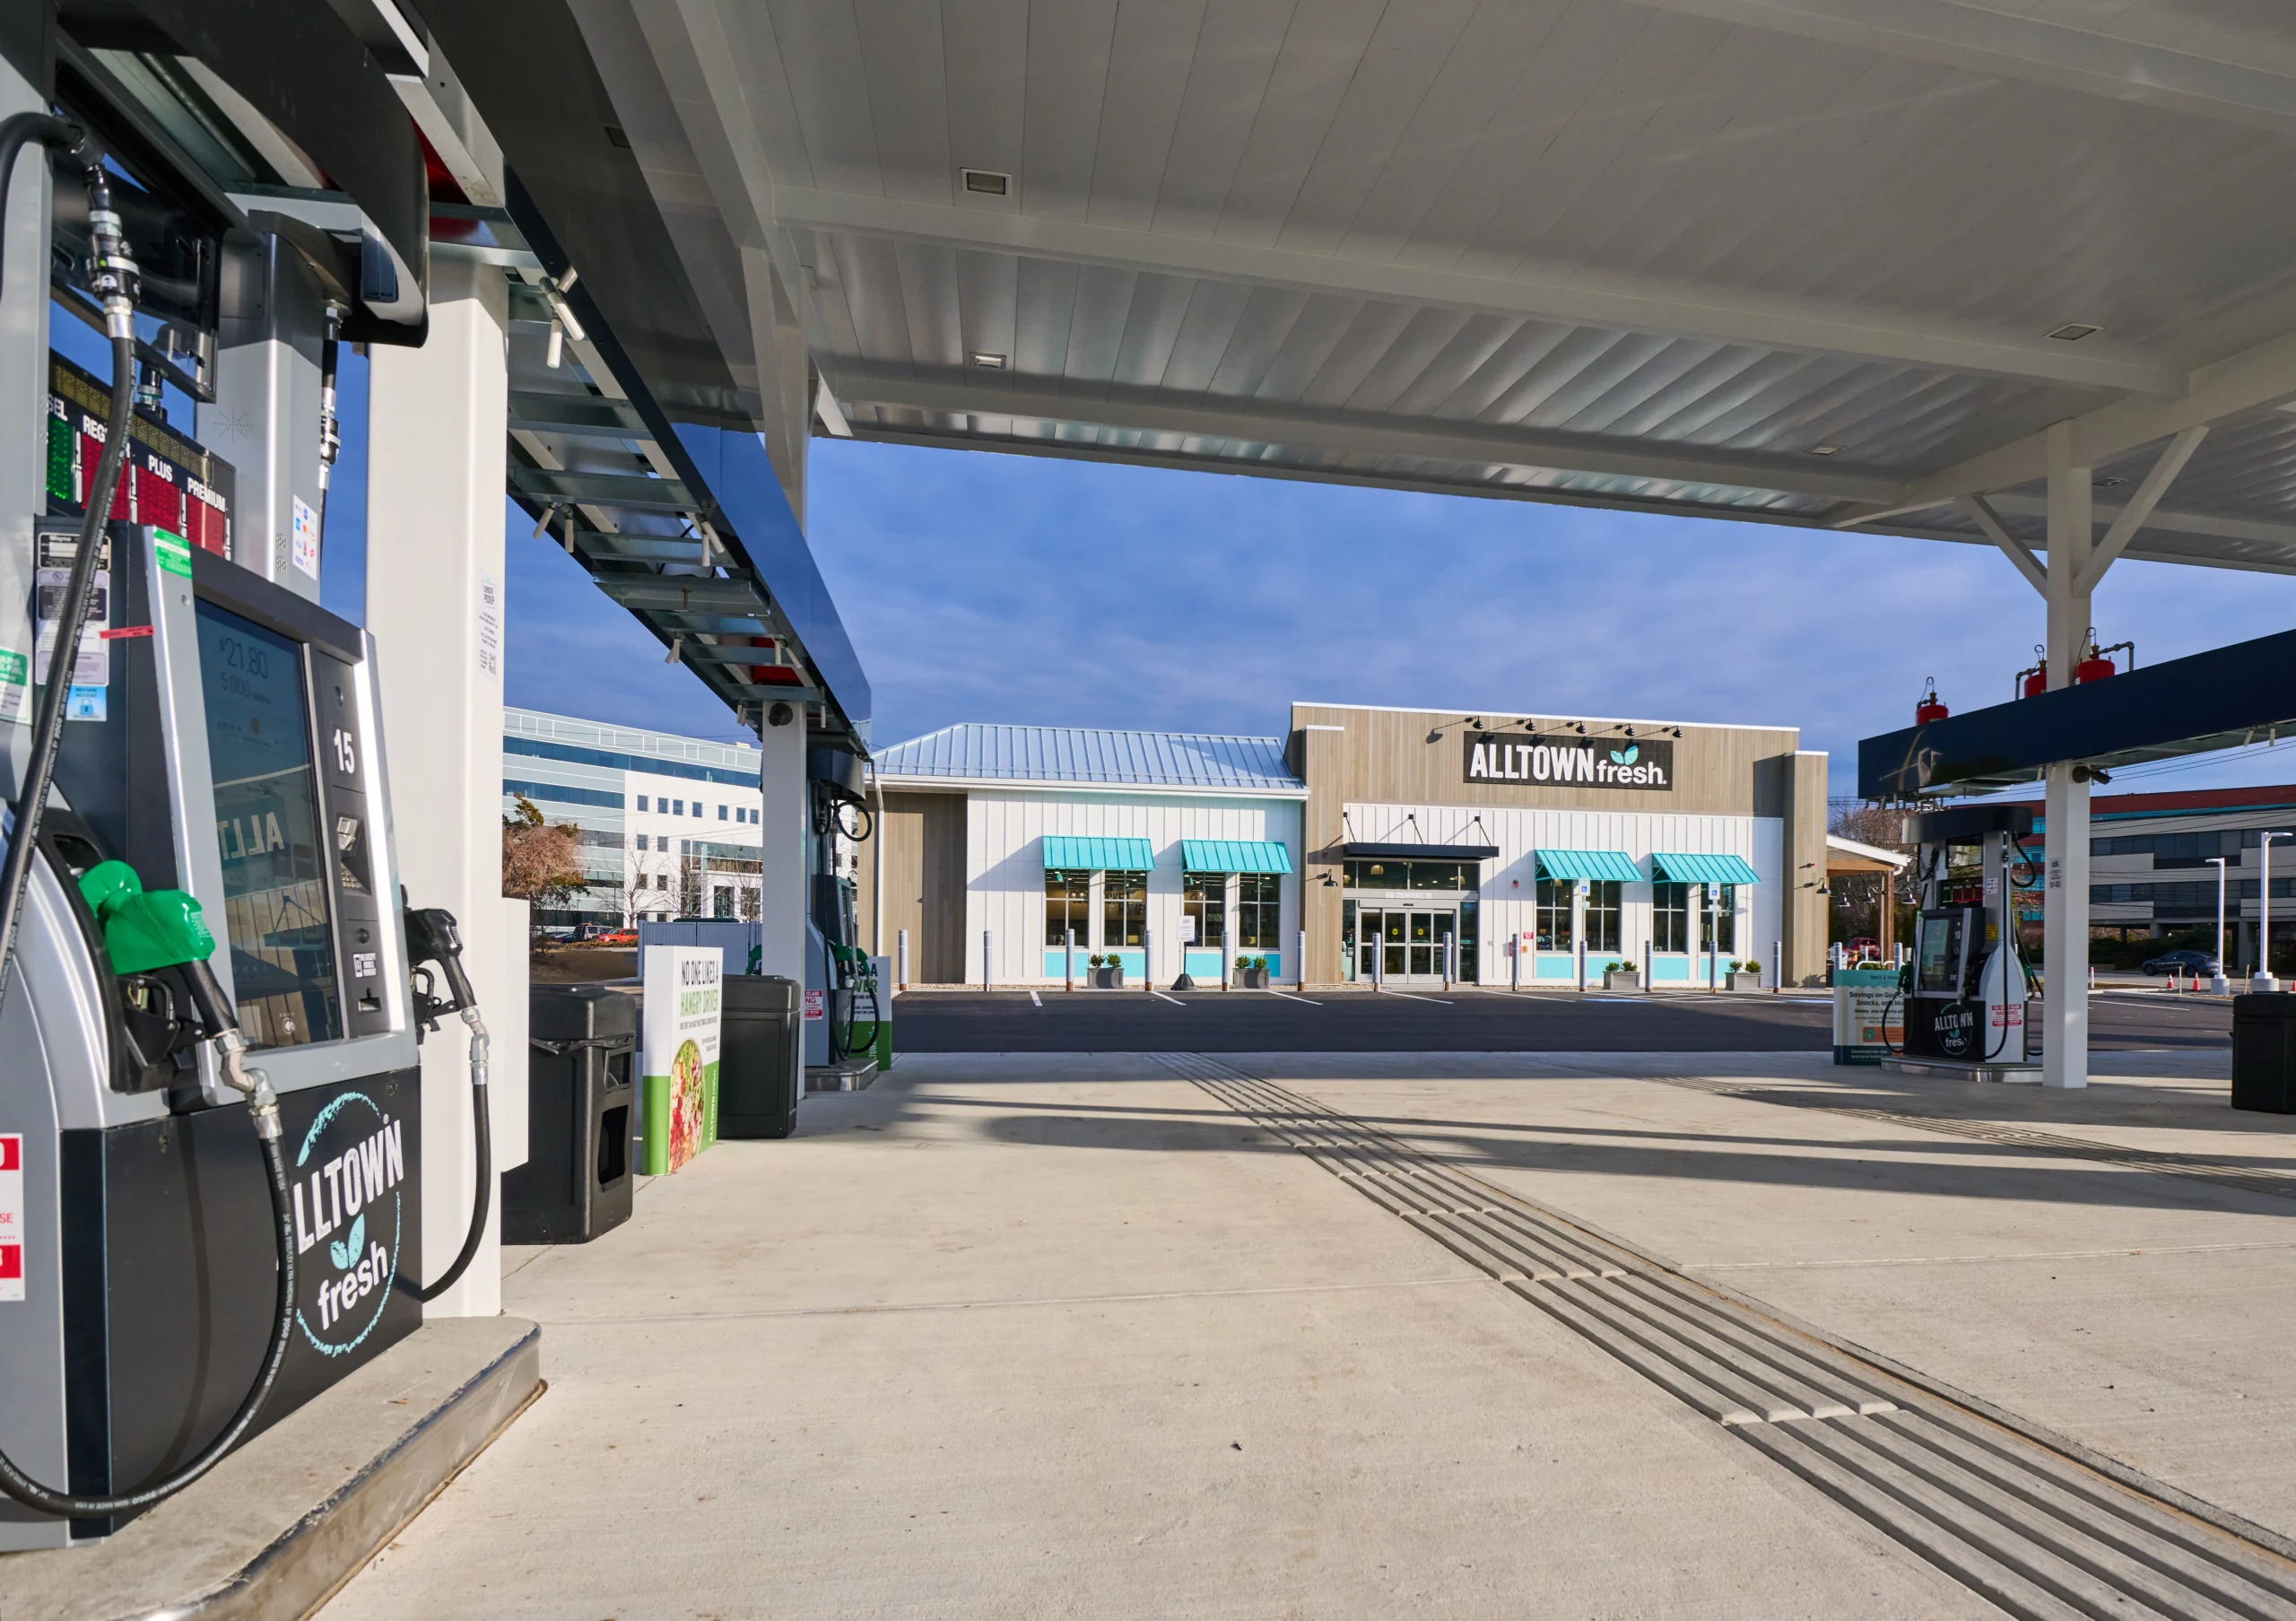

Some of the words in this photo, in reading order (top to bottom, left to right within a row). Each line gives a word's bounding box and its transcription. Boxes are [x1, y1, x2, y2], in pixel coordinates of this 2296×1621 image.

[148, 455, 172, 483] PLUS
[187, 477, 226, 513] PREMIUM
[334, 728, 355, 774] 15
[1469, 743, 1595, 783] ALLTOWN
[1596, 759, 1663, 786] fresh
[681, 960, 690, 986] NO
[691, 960, 701, 986] ONE
[702, 960, 715, 985] LIKES
[871, 963, 878, 977] A
[680, 990, 702, 1017] HANGRY
[703, 989, 718, 1013] DRIVER
[1848, 991, 1874, 999] Savings
[293, 1120, 404, 1255] LLTOWN
[317, 1241, 388, 1331] fresh
